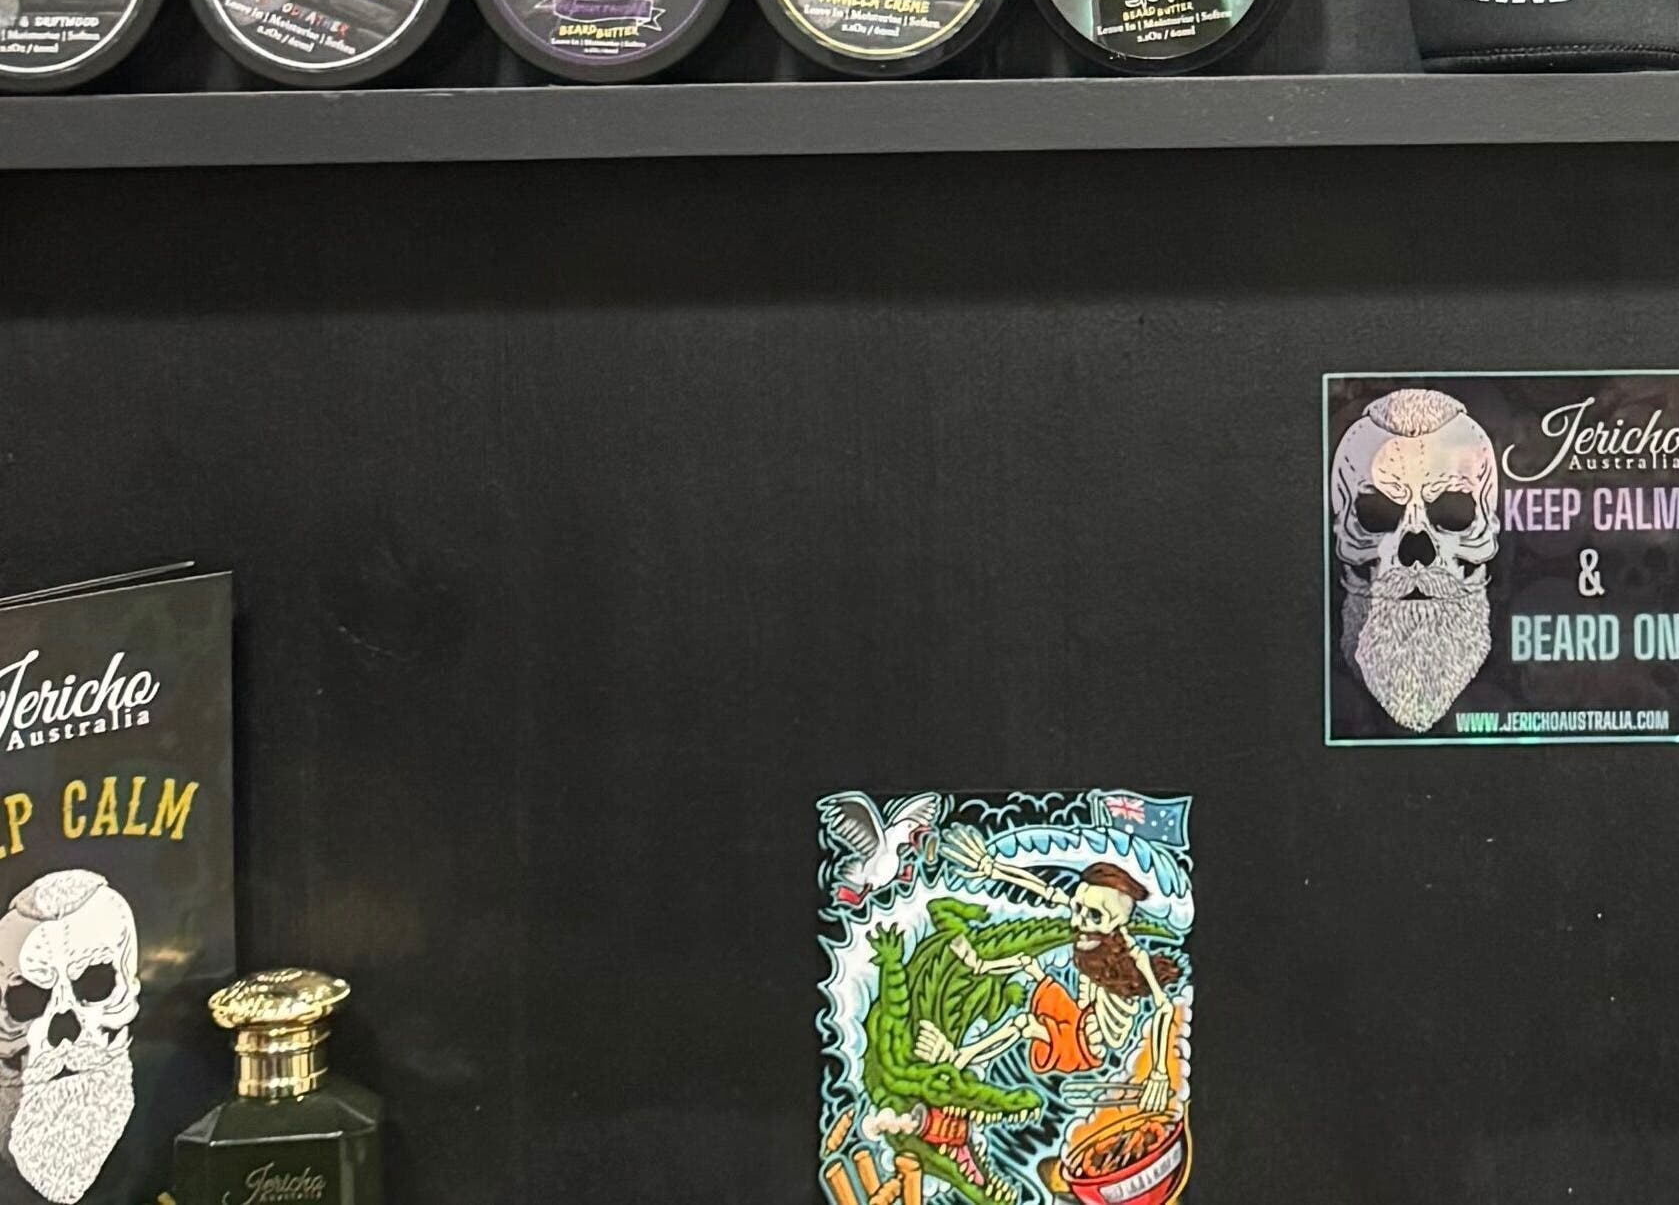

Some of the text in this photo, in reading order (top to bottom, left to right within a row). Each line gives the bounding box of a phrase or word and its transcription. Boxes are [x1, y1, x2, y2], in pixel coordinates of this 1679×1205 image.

[1123, 1, 1194, 22] BEARD BUTTER
[1504, 488, 1581, 532] KEEP
[1578, 548, 1605, 596] &
[1511, 614, 1619, 662] BEARD
[6, 709, 150, 751] Australia
[1456, 709, 1669, 733] WWW.JERICHOAUSTRALIA.COM
[62, 776, 199, 840] CALM
